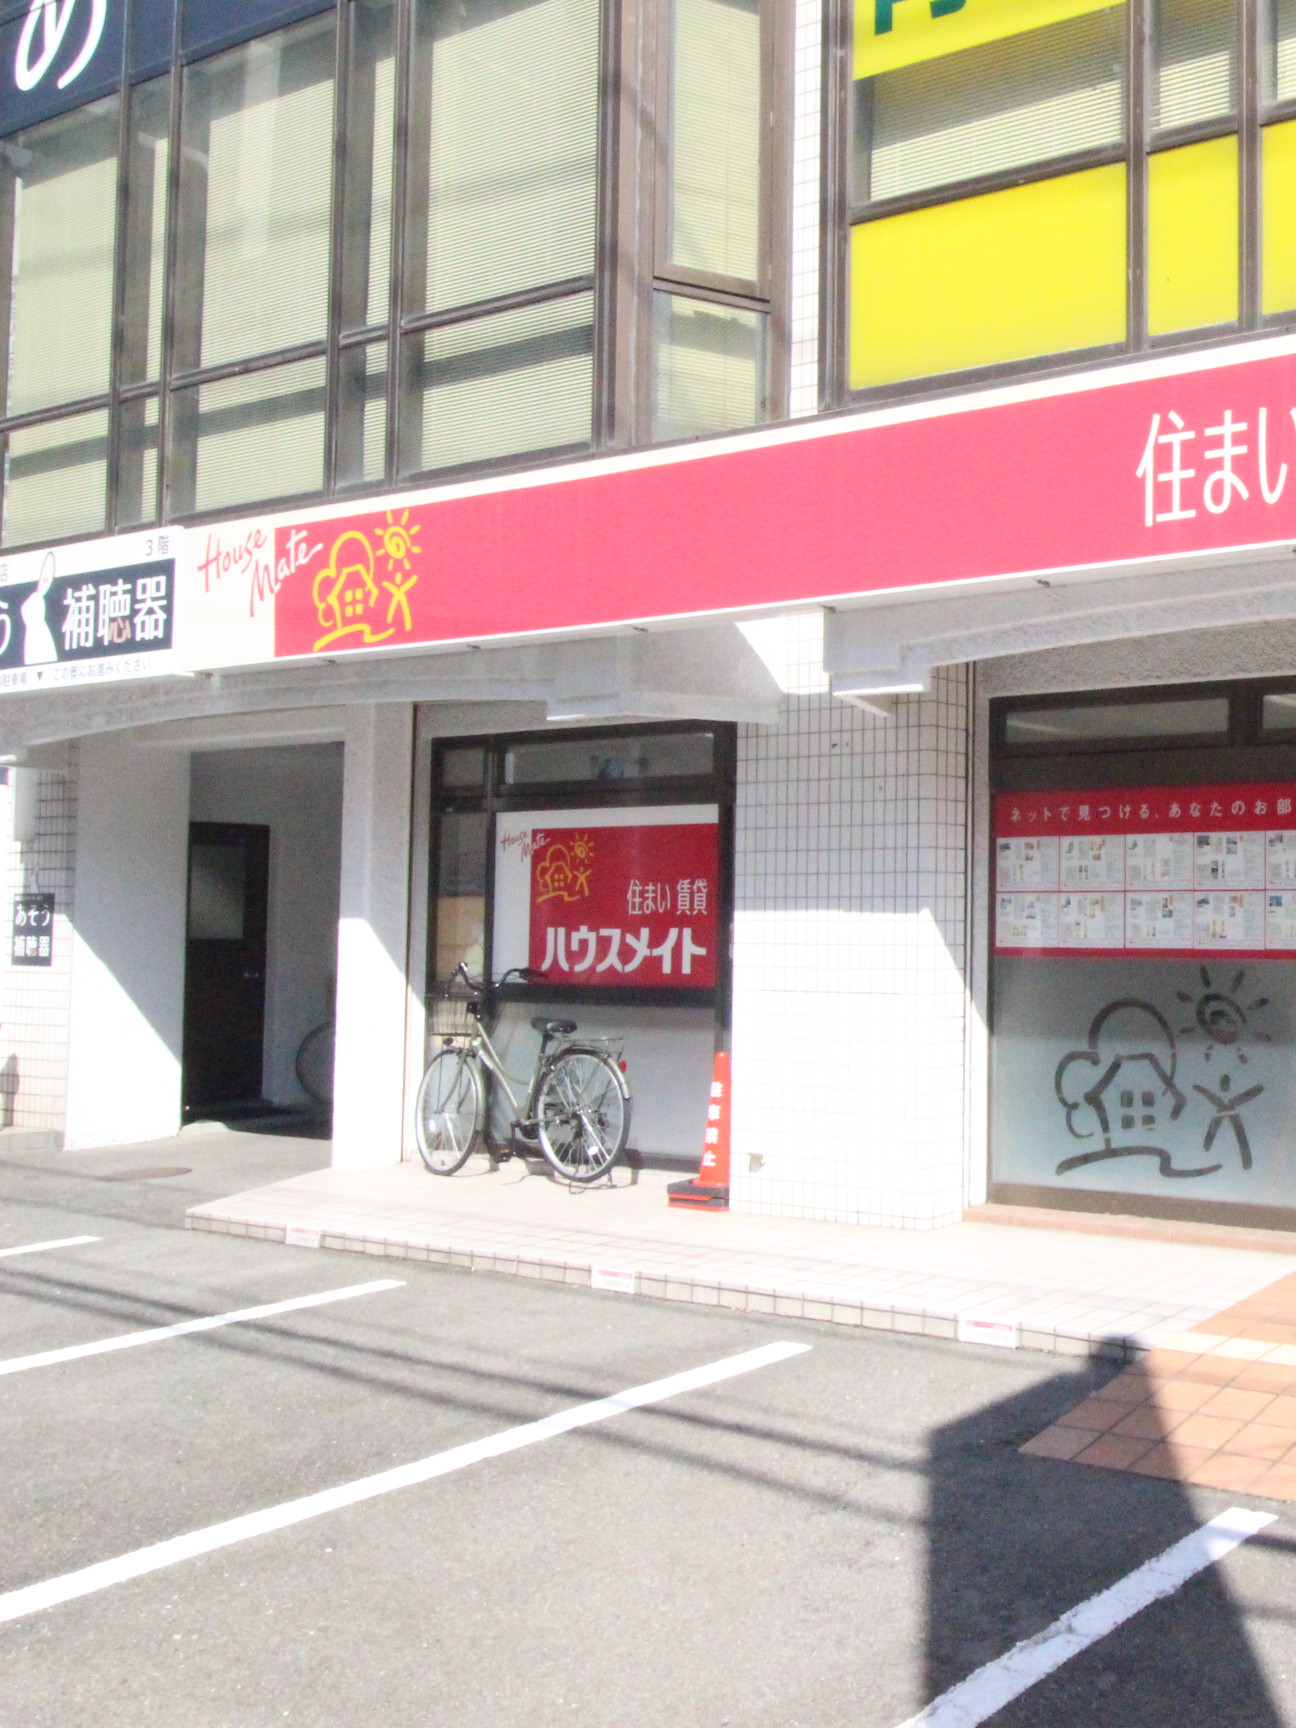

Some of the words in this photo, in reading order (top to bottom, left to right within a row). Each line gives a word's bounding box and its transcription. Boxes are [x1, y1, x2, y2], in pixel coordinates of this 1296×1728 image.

[197, 528, 267, 593] House
[250, 529, 324, 618] Mate
[62, 575, 168, 651] 補聴器
[15, 903, 51, 927] あそう
[627, 878, 671, 916] 住まい
[676, 878, 708, 916] 賃貸
[541, 925, 707, 975] ハウスメイト
